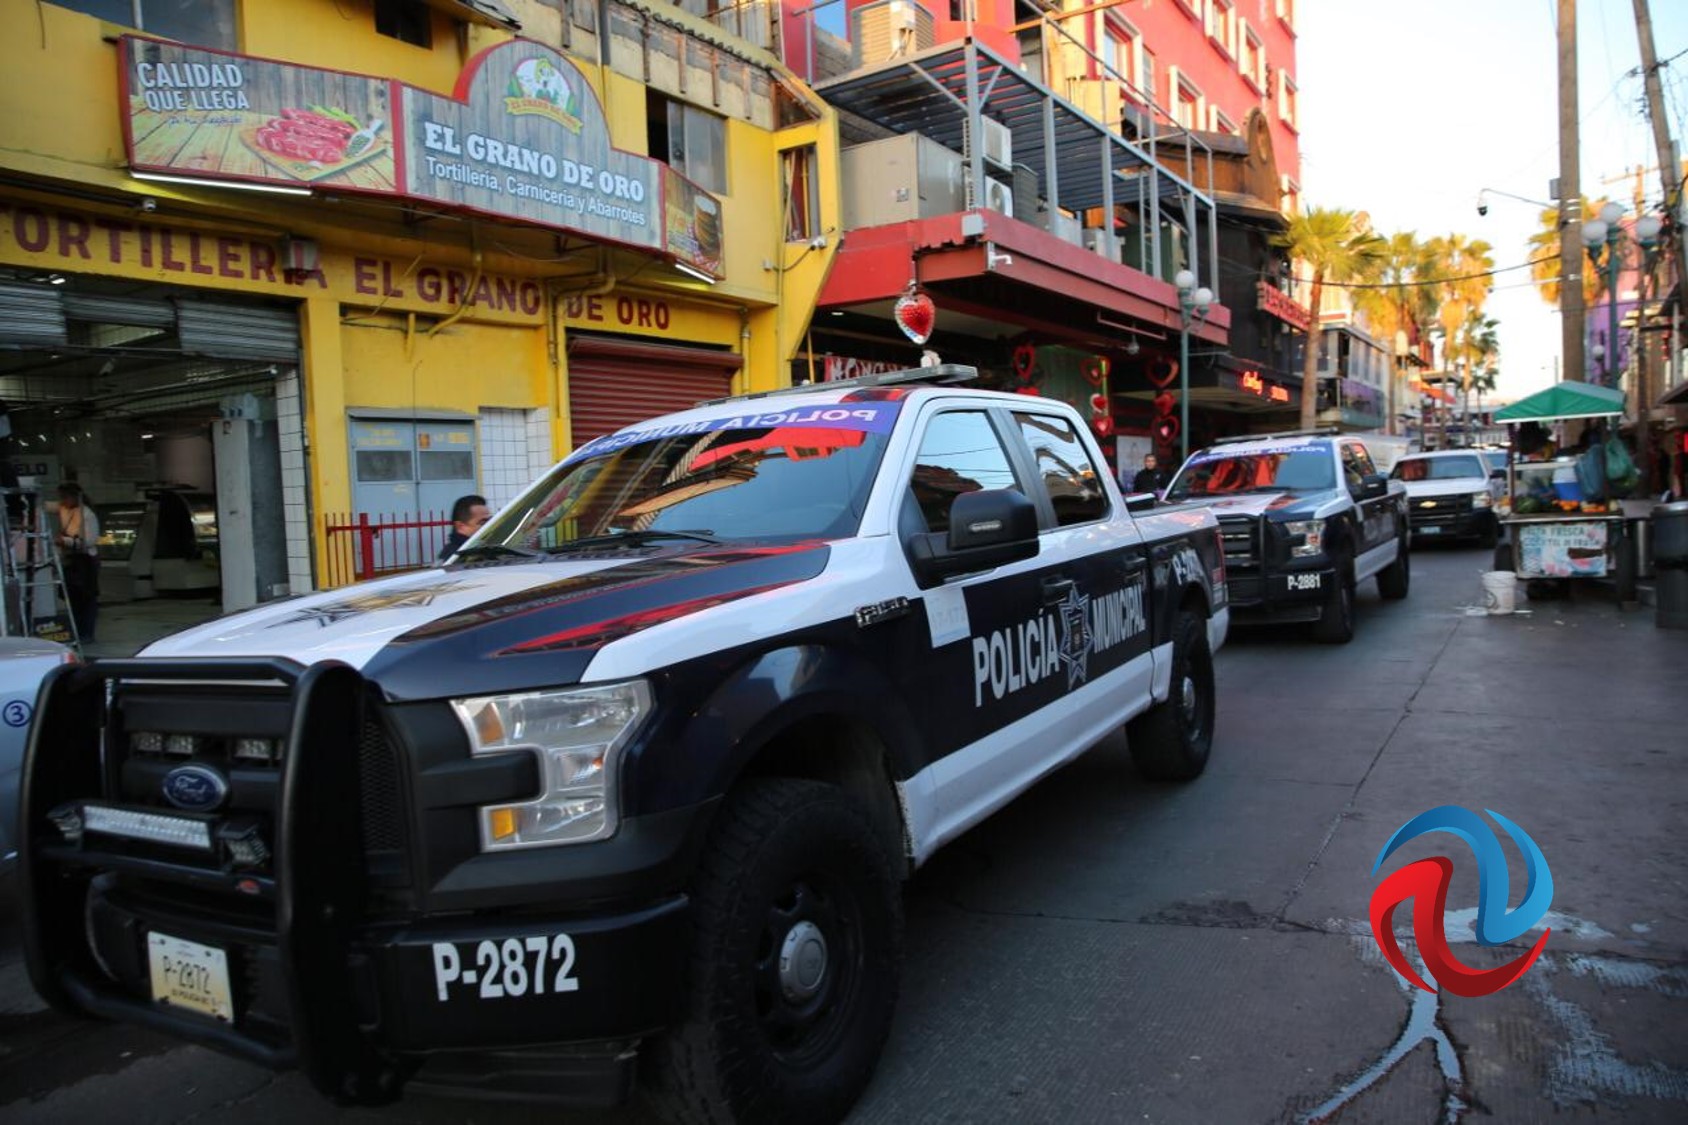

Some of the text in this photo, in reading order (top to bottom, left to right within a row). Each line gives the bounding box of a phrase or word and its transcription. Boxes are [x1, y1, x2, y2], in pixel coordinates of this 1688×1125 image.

[136, 62, 243, 88] CALIDAD
[145, 90, 250, 113] QUE LLEGA
[424, 121, 645, 203] EL GRANO DE ORO
[577, 197, 587, 214] y
[588, 198, 645, 225] Abarrotes
[354, 257, 404, 298] EL
[416, 266, 541, 316] GRANO
[565, 294, 604, 322] DE
[616, 295, 671, 331] ORO
[972, 582, 1147, 708] POLICÍA MUNICIPAL
[432, 933, 579, 1002] P-2872
